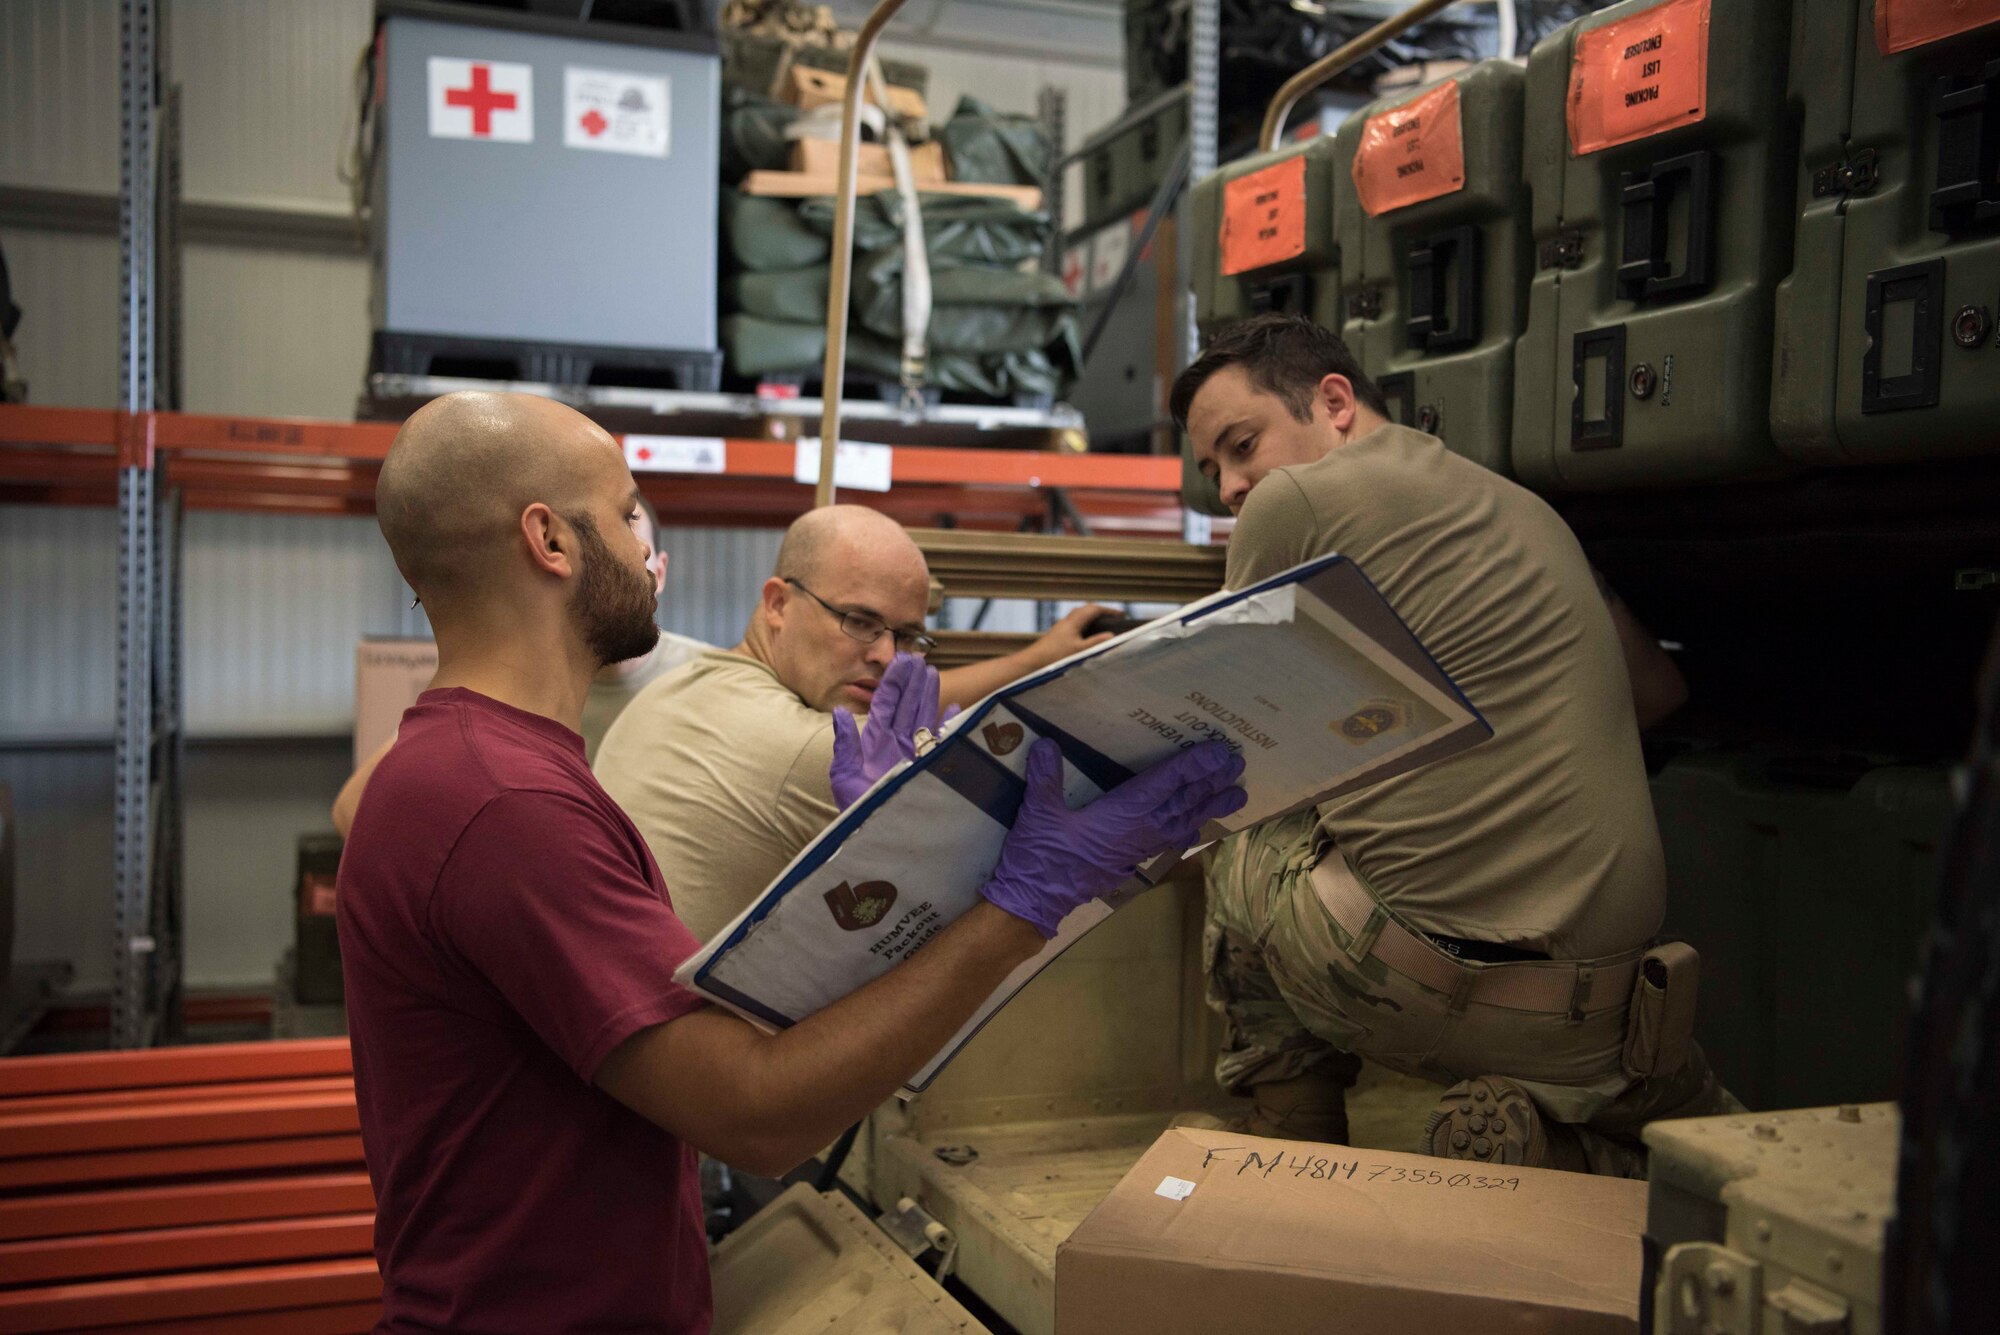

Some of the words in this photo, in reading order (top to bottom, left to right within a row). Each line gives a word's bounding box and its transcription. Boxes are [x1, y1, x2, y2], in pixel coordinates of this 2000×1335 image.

[1624, 34, 1662, 60] ENCLOSED
[1642, 60, 1661, 78] LIST
[1625, 85, 1659, 108] PACKING
[1127, 707, 1184, 744] VEHICLE
[1173, 711, 1243, 752] PACK-OUT
[1184, 691, 1279, 750] INSTRUCTIONS
[869, 901, 933, 955] HUMVEE
[882, 911, 941, 961] Packout
